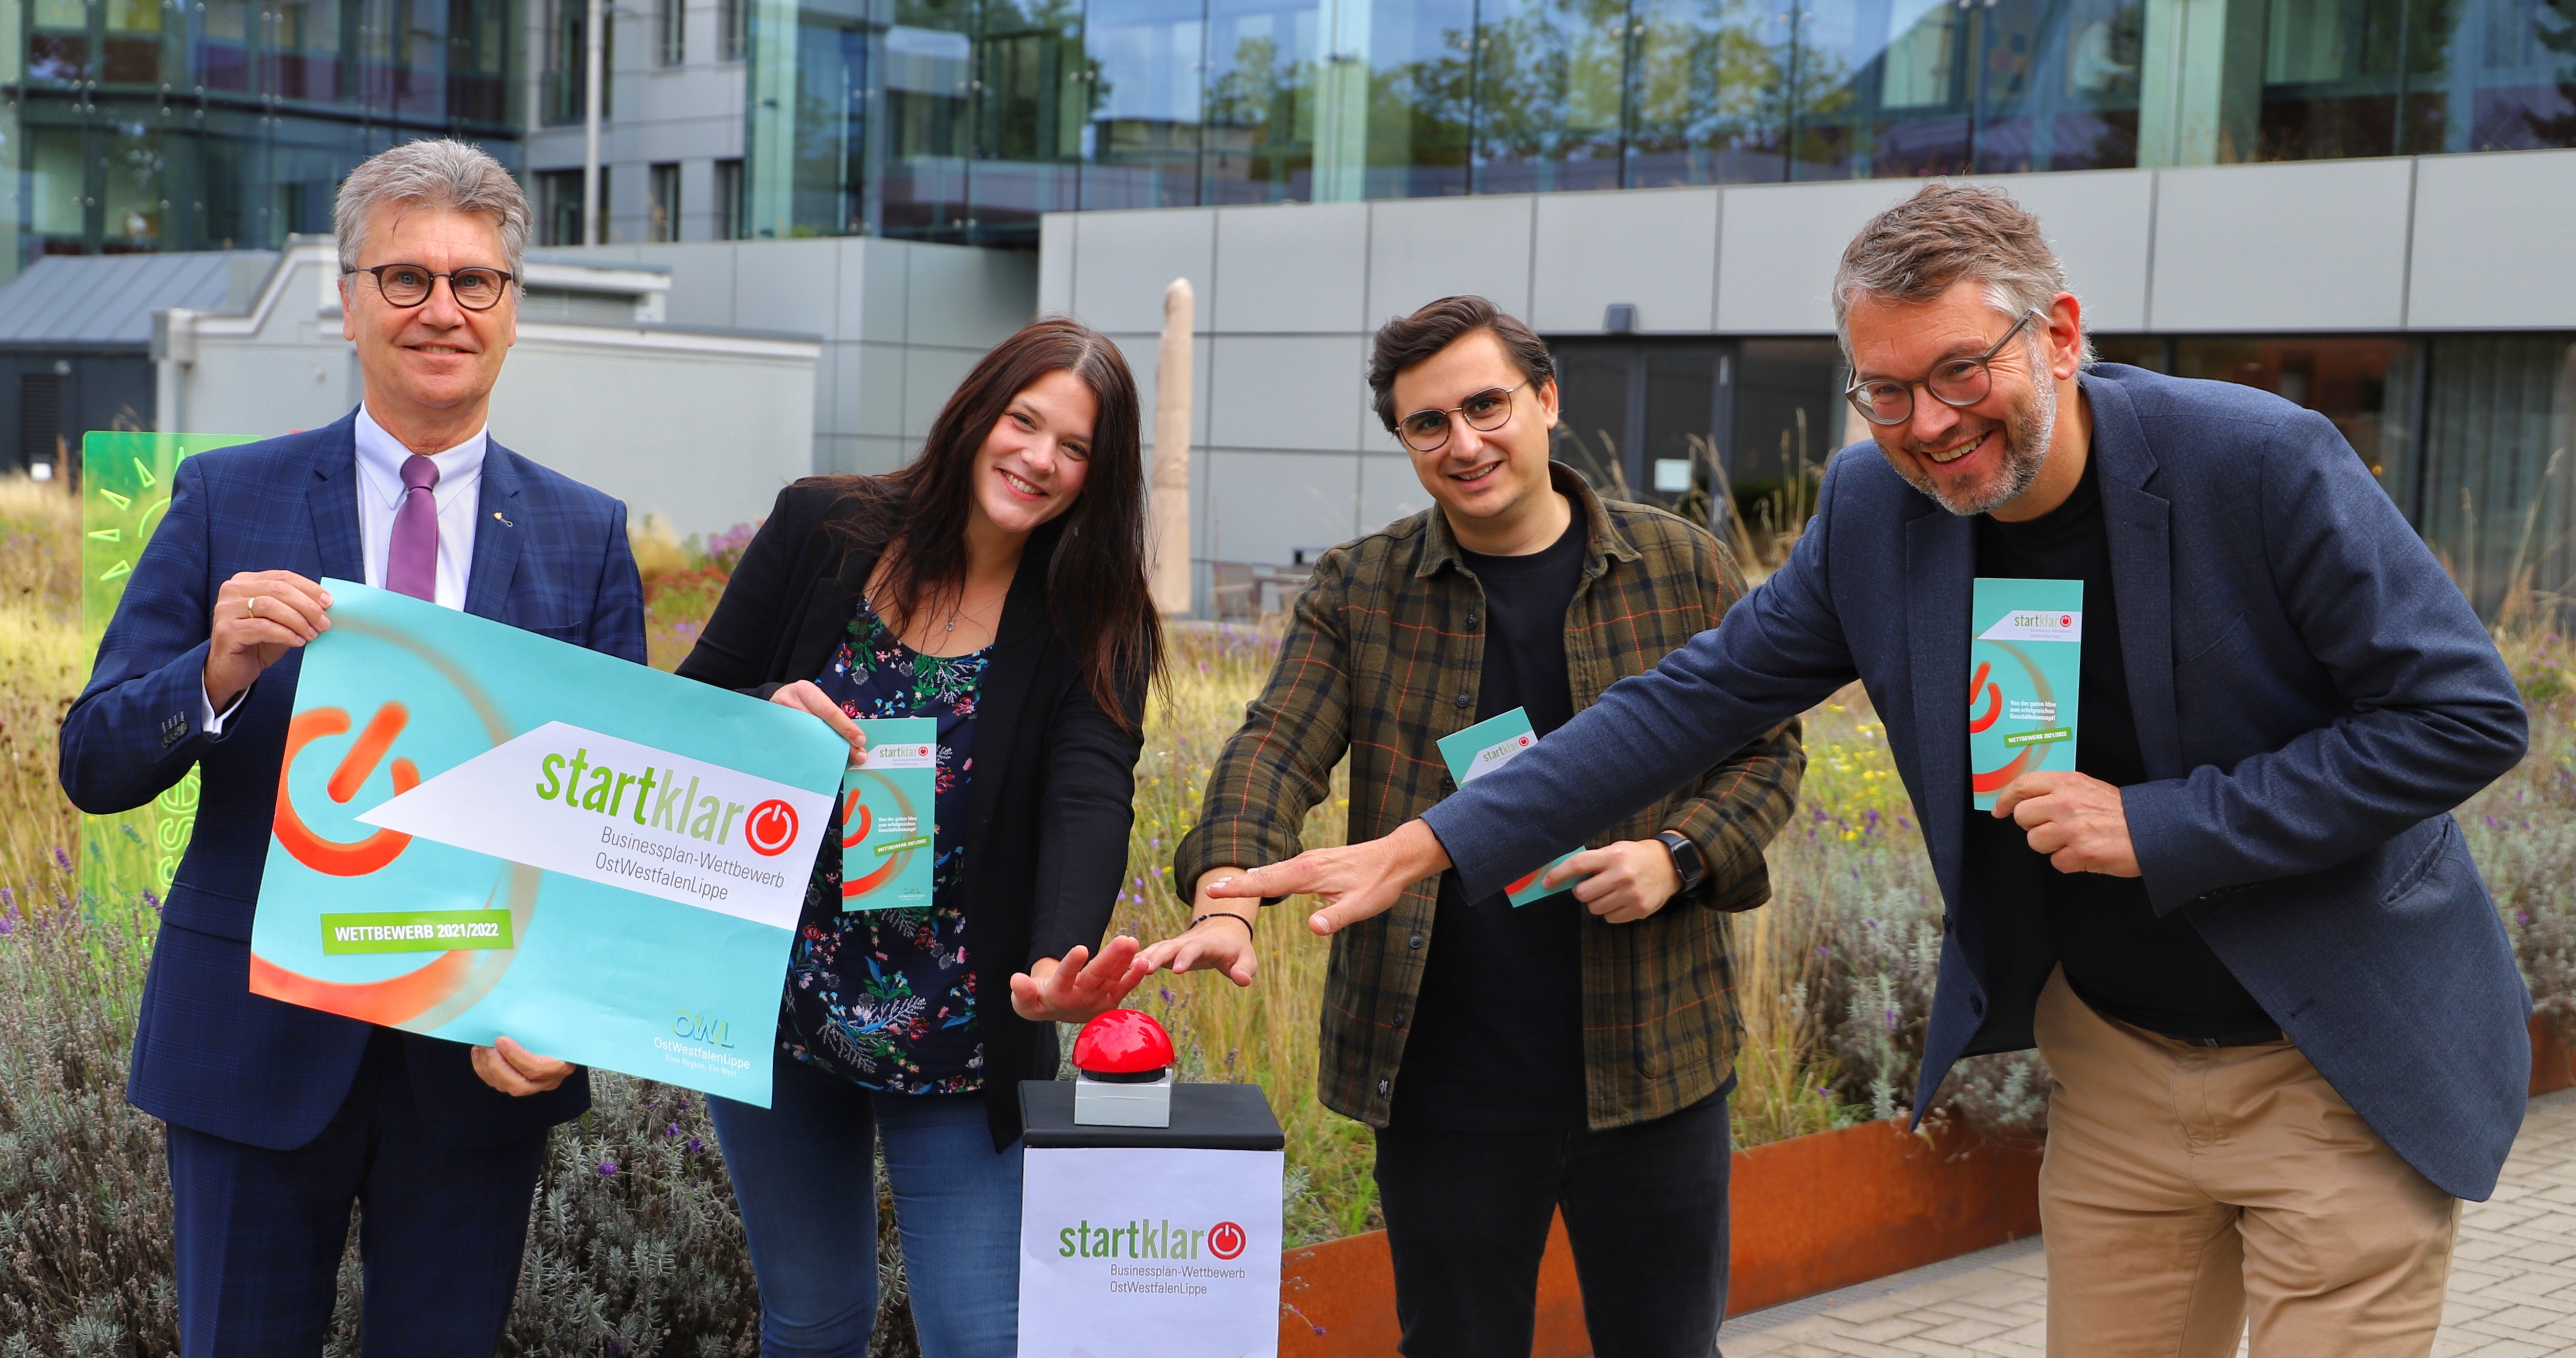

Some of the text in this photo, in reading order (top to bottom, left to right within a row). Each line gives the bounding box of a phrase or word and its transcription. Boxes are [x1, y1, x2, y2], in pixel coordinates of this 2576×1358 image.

[2014, 614, 2059, 626] startklar
[2008, 734, 2043, 743] WETTBEWERB
[880, 747, 917, 757] startklar
[1483, 742, 1519, 762] startklar
[536, 747, 745, 845] startklar
[601, 825, 785, 889] Businessplan-Wettbewerb
[877, 843, 907, 852] WETTBEWERB
[595, 851, 728, 901] OstWestfalenLippe
[334, 922, 499, 941] WETTBEWERB 2021/2022
[671, 1010, 735, 1049] OWL
[654, 1037, 750, 1069] OstWestfalenLippe
[665, 1053, 739, 1078] Eine Region. Ein Wort.
[1058, 1219, 1204, 1260] startklar
[1110, 1264, 1246, 1279] Businessplan-Wettbewerb
[1110, 1280, 1207, 1296] OstWestfalenLippe
